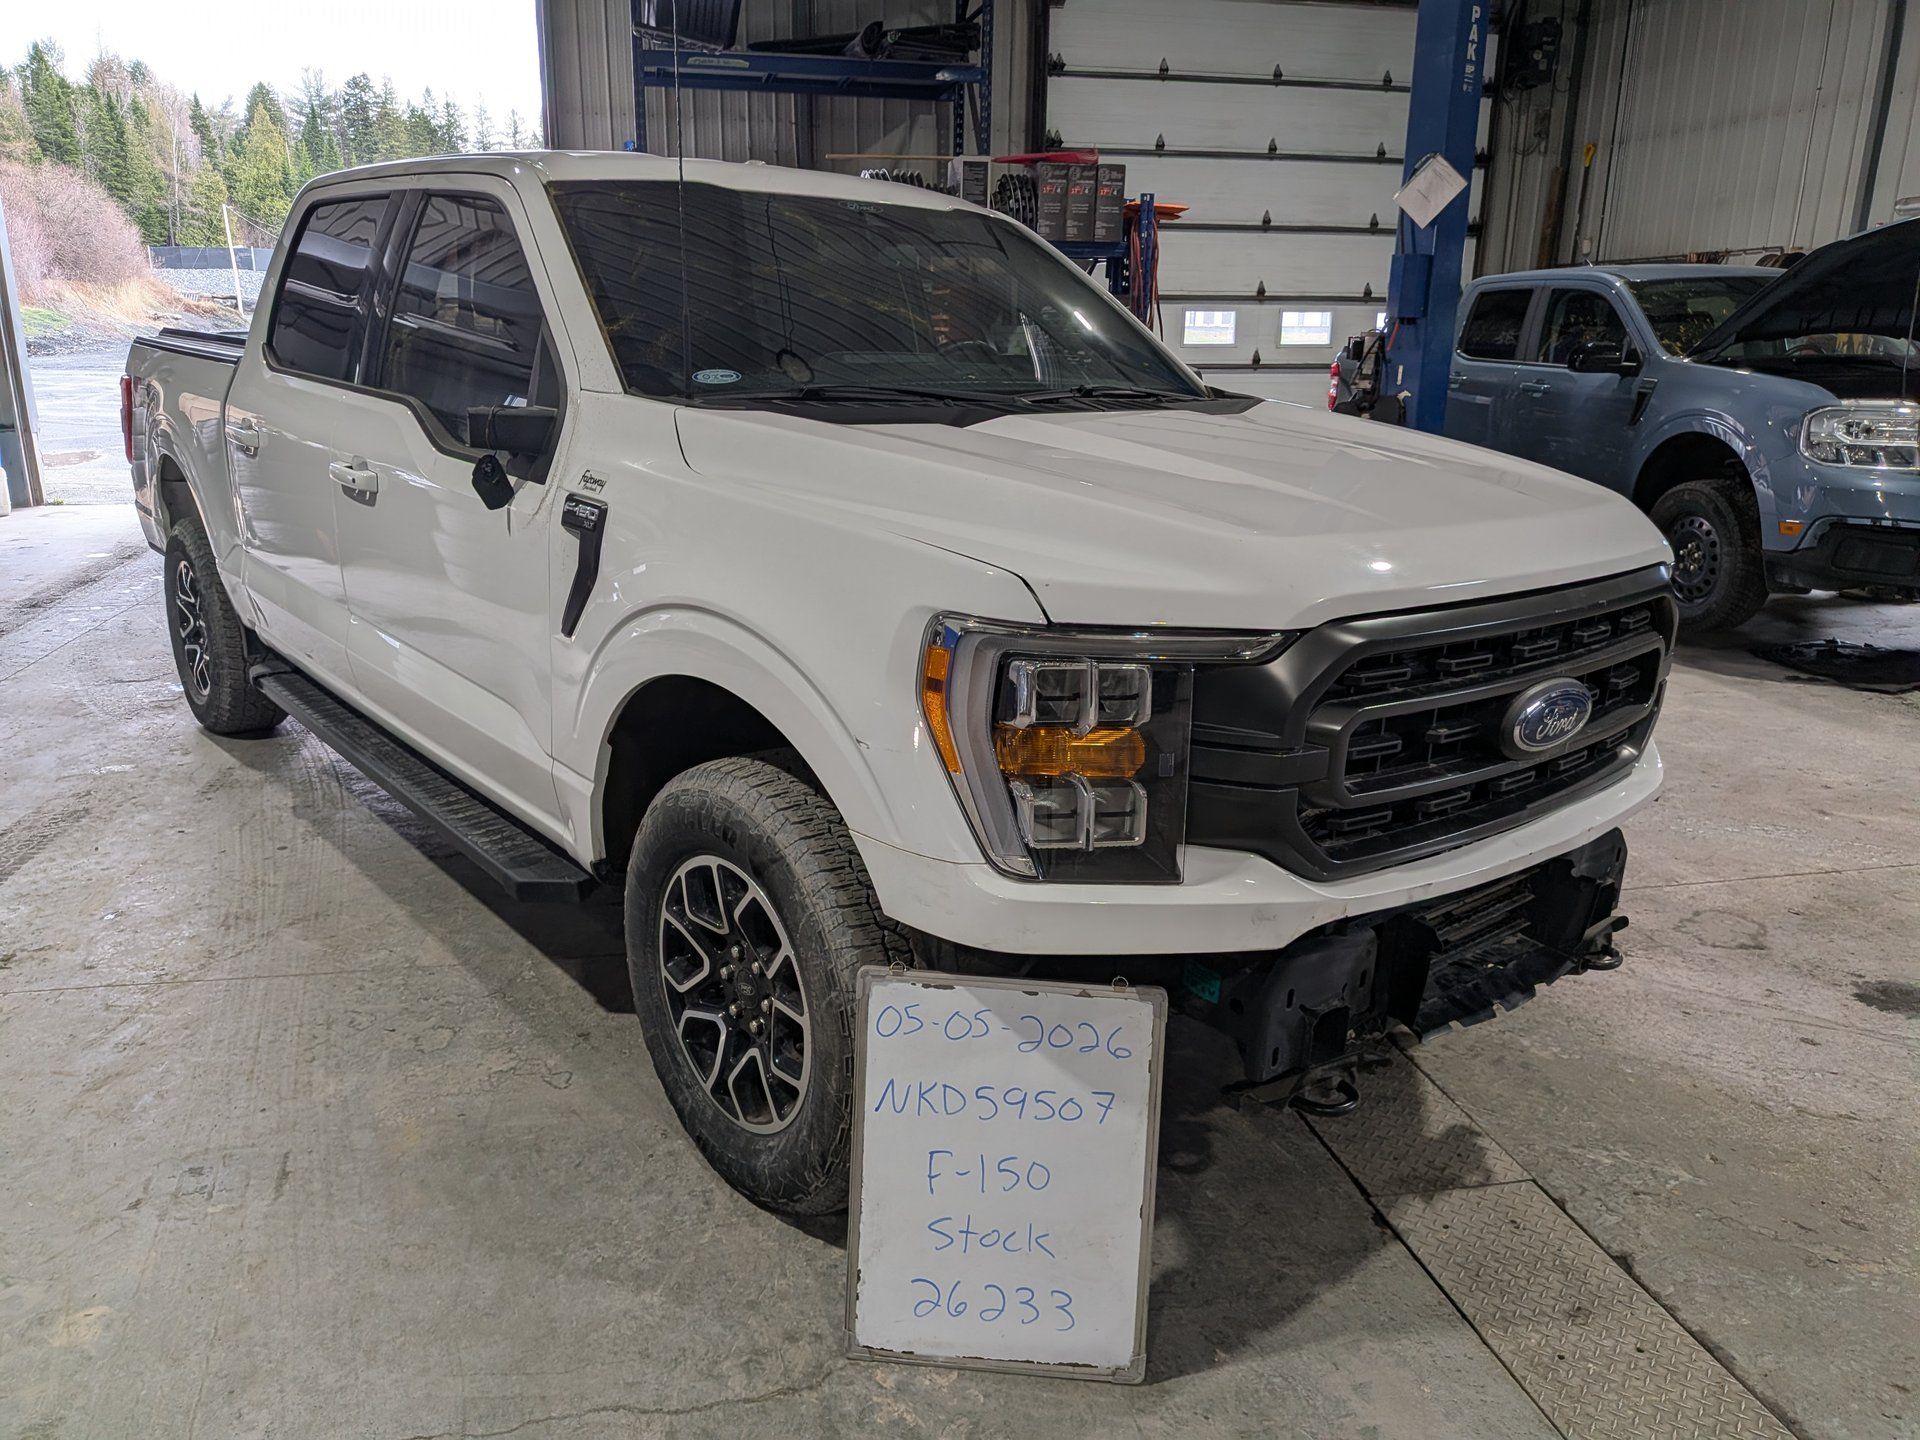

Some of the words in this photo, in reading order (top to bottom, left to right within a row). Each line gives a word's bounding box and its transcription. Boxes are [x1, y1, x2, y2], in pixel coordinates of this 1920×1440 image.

[1536, 706, 1579, 741] Ford
[875, 1003, 1132, 1059] 05-05-2026
[874, 1077, 1116, 1125] NKD59507
[927, 1150, 1051, 1195] F-150
[927, 1214, 1056, 1259] Stock
[910, 1278, 1076, 1332] 26233
